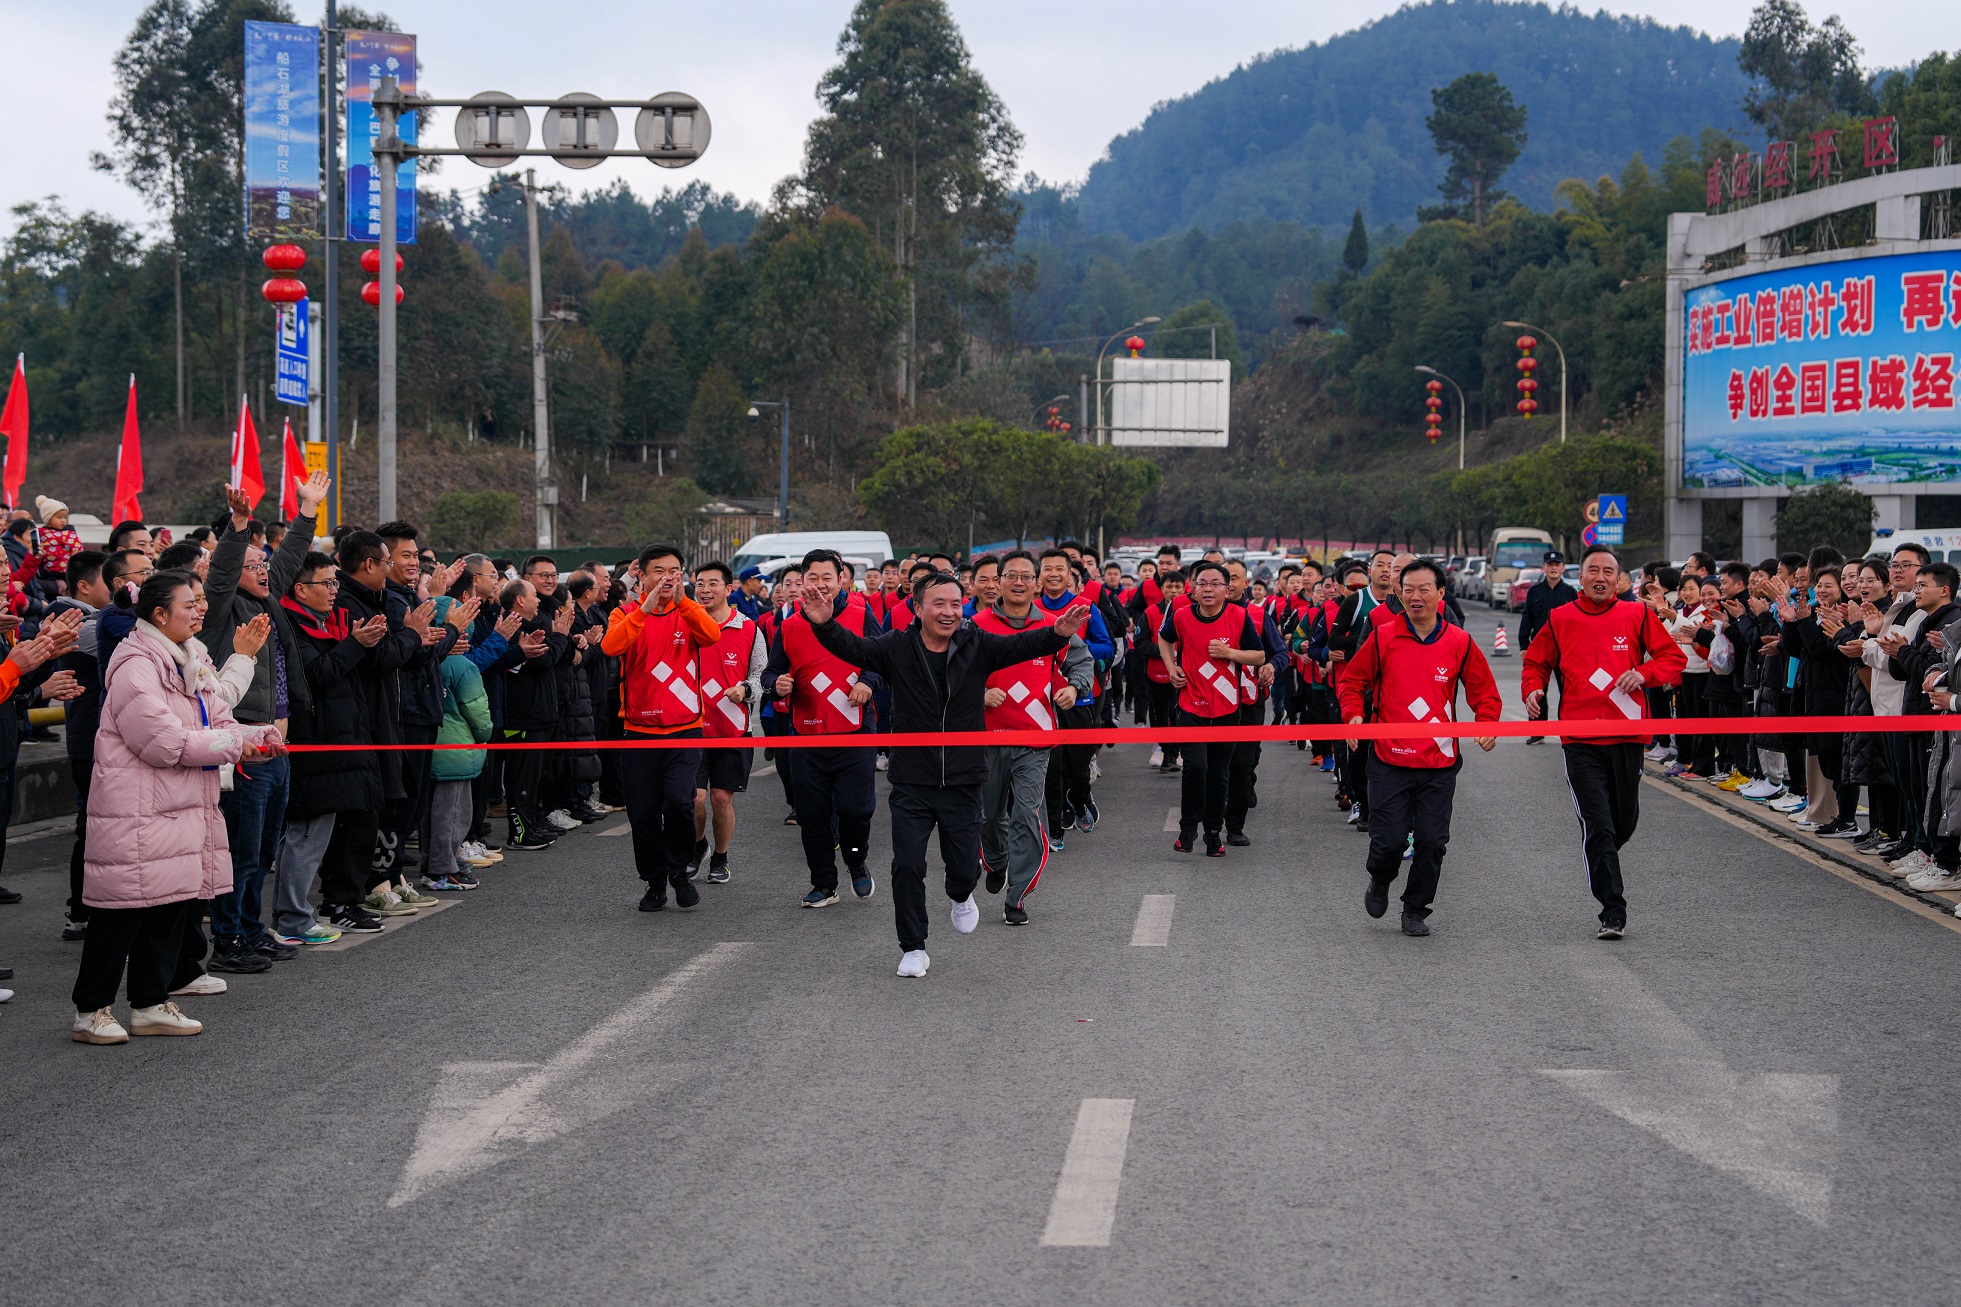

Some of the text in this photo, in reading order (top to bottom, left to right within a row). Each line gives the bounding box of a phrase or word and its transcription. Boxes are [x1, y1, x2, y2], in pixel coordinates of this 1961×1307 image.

[276, 51, 291, 220] 船石湖旅游度假区欢迎您
[1688, 270, 1961, 356] 实施工业倍增计划 再
[1727, 353, 1961, 422] 争创全国县域经
[1922, 535, 1945, 547] 急救
[371, 828, 398, 868] 23
